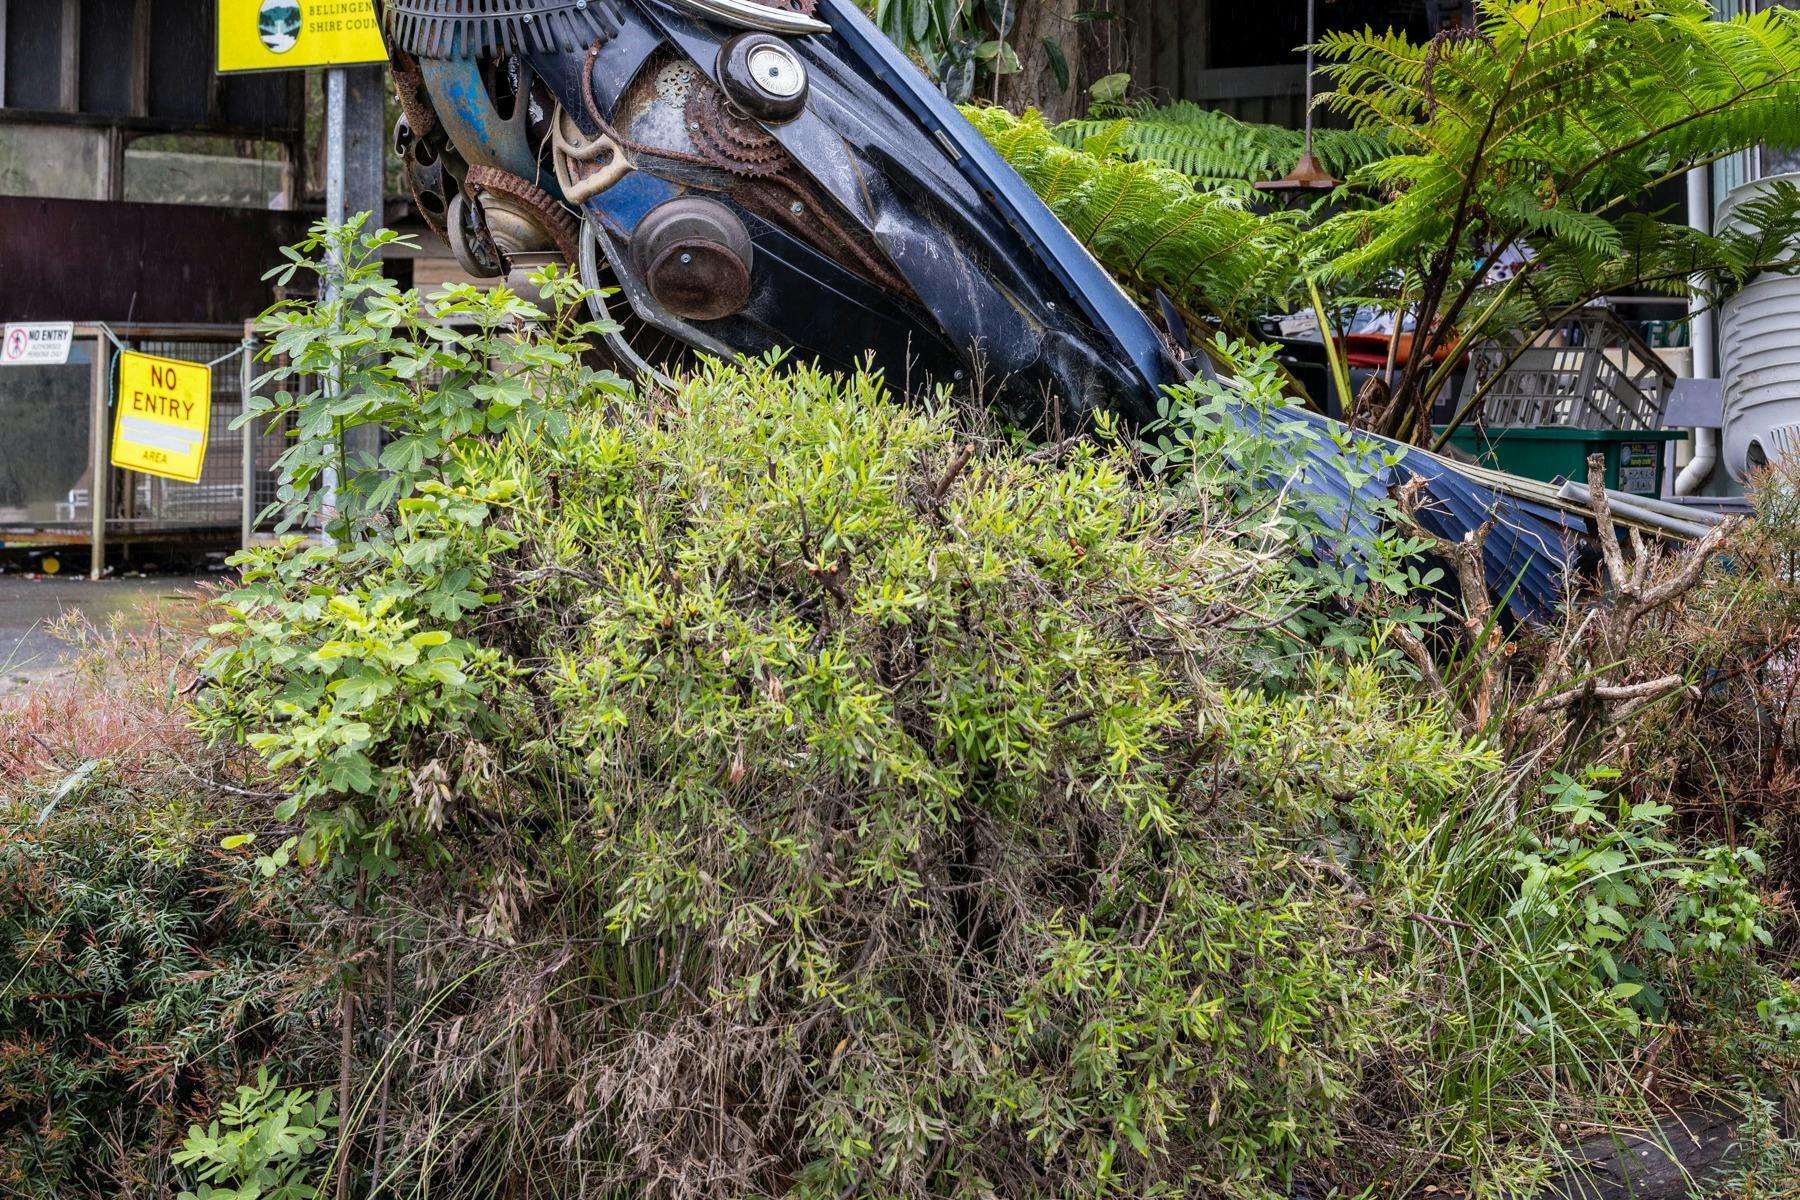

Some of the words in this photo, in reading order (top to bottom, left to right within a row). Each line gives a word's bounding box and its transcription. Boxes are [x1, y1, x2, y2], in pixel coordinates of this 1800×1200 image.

[309, 20, 342, 33] SHIRE
[29, 329, 40, 340] NO
[41, 329, 68, 341] ENTRY
[151, 365, 177, 390] NO
[133, 391, 194, 421] ENTRY
[142, 450, 168, 464] AREA
